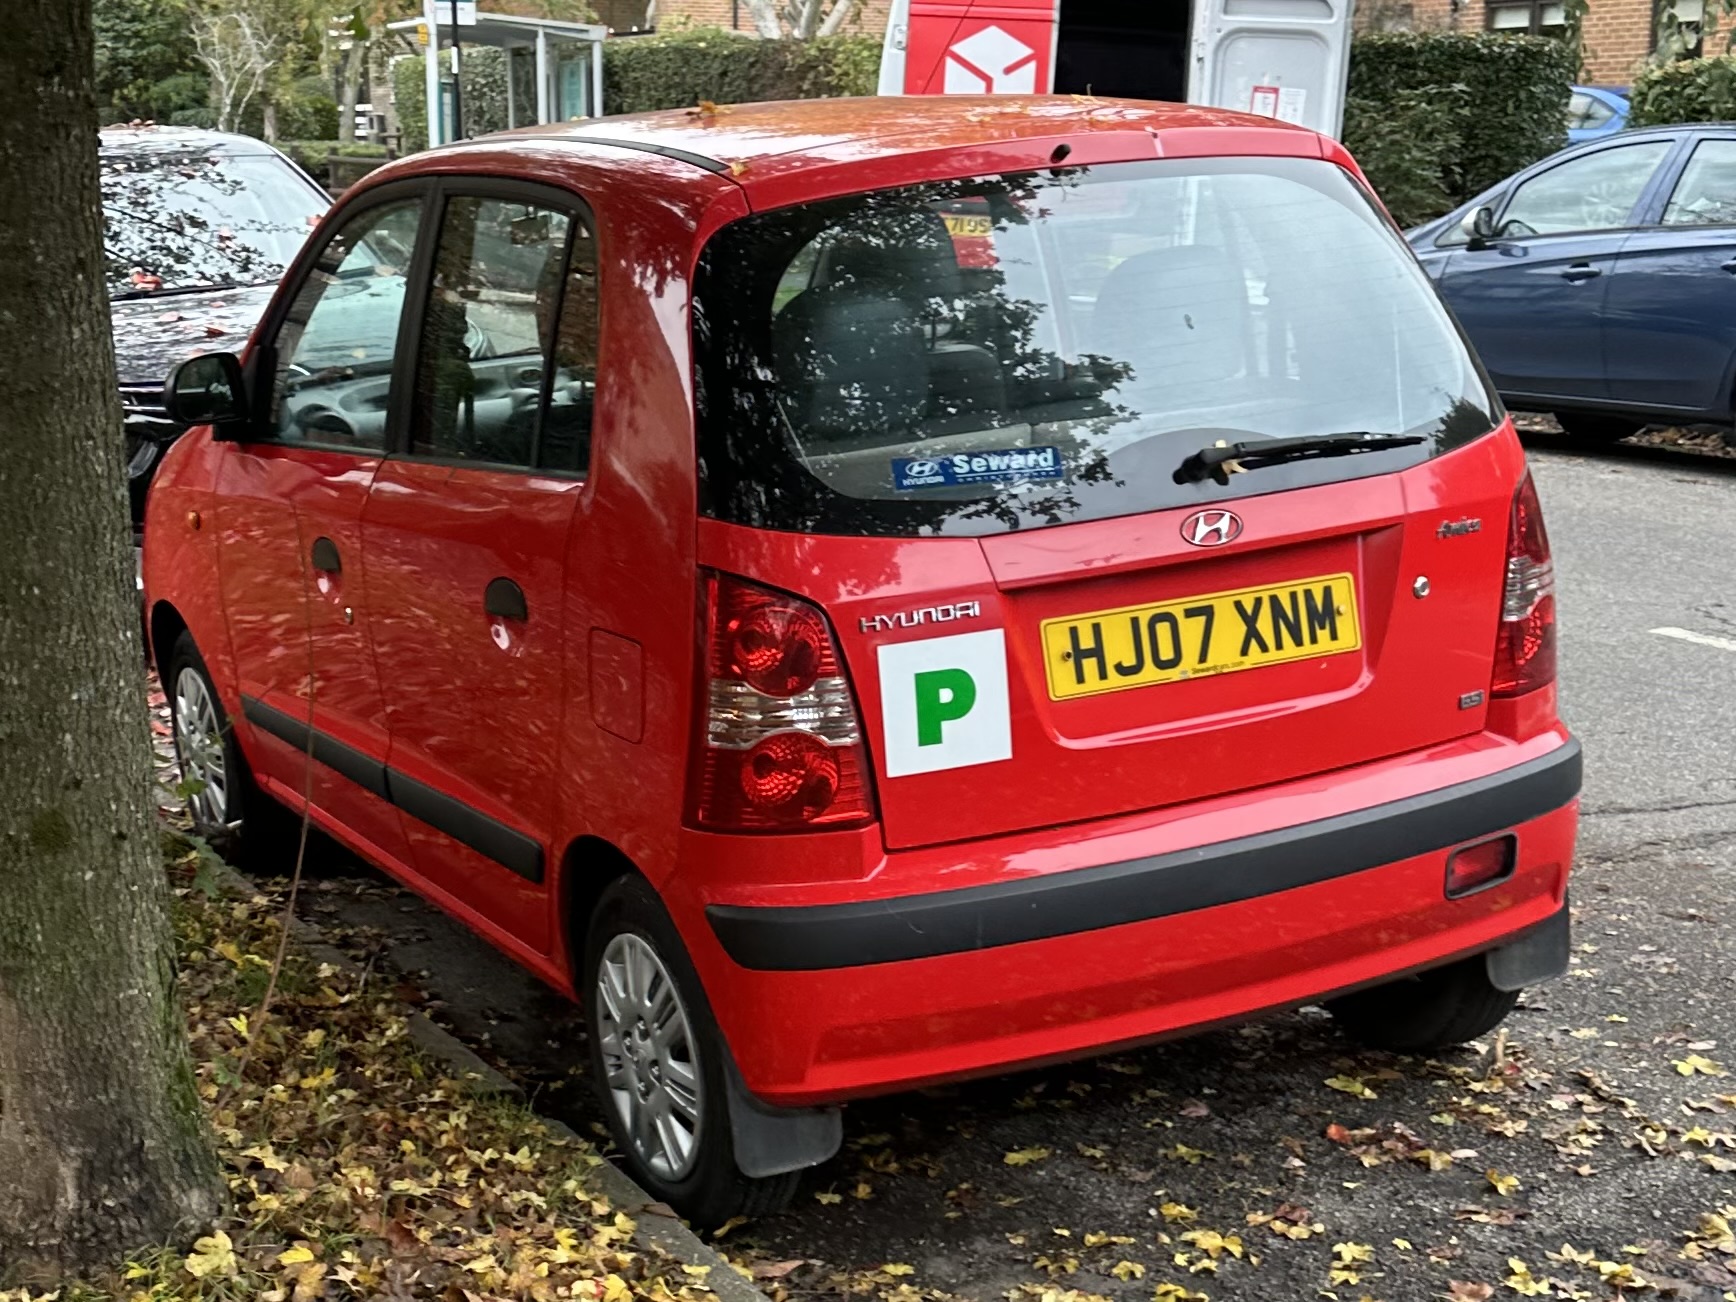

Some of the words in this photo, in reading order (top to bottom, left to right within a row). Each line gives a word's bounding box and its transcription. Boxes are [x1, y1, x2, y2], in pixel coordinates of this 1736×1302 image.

[953, 448, 1055, 474] Seward
[860, 600, 980, 633] HYUNDAI
[1069, 604, 1215, 685] HJ07
[1233, 585, 1339, 657] XNM
[914, 668, 977, 747] P
